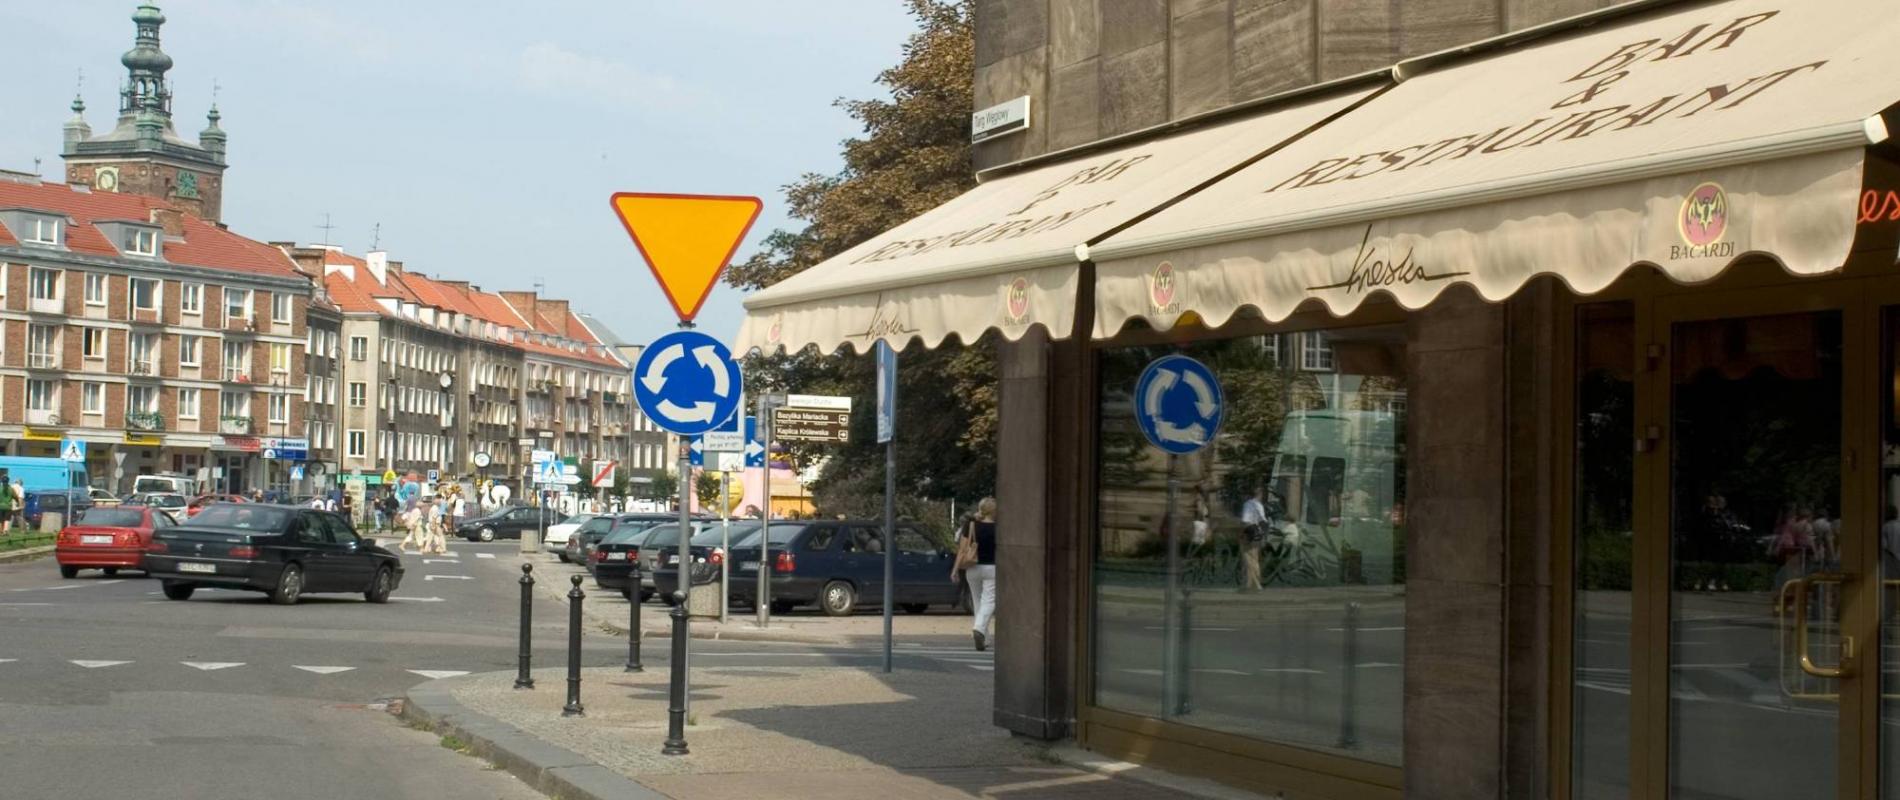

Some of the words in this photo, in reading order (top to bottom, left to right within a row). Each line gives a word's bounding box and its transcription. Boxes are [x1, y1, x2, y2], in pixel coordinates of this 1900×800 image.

[1560, 9, 1781, 84] BAR
[1549, 70, 1630, 110] &
[1264, 59, 1828, 194] RESTAURANT
[1669, 241, 1735, 260] BACARDI
[777, 411, 801, 420] Bazylika
[802, 412, 829, 420] Mariacka
[776, 427, 799, 437] Kaplica
